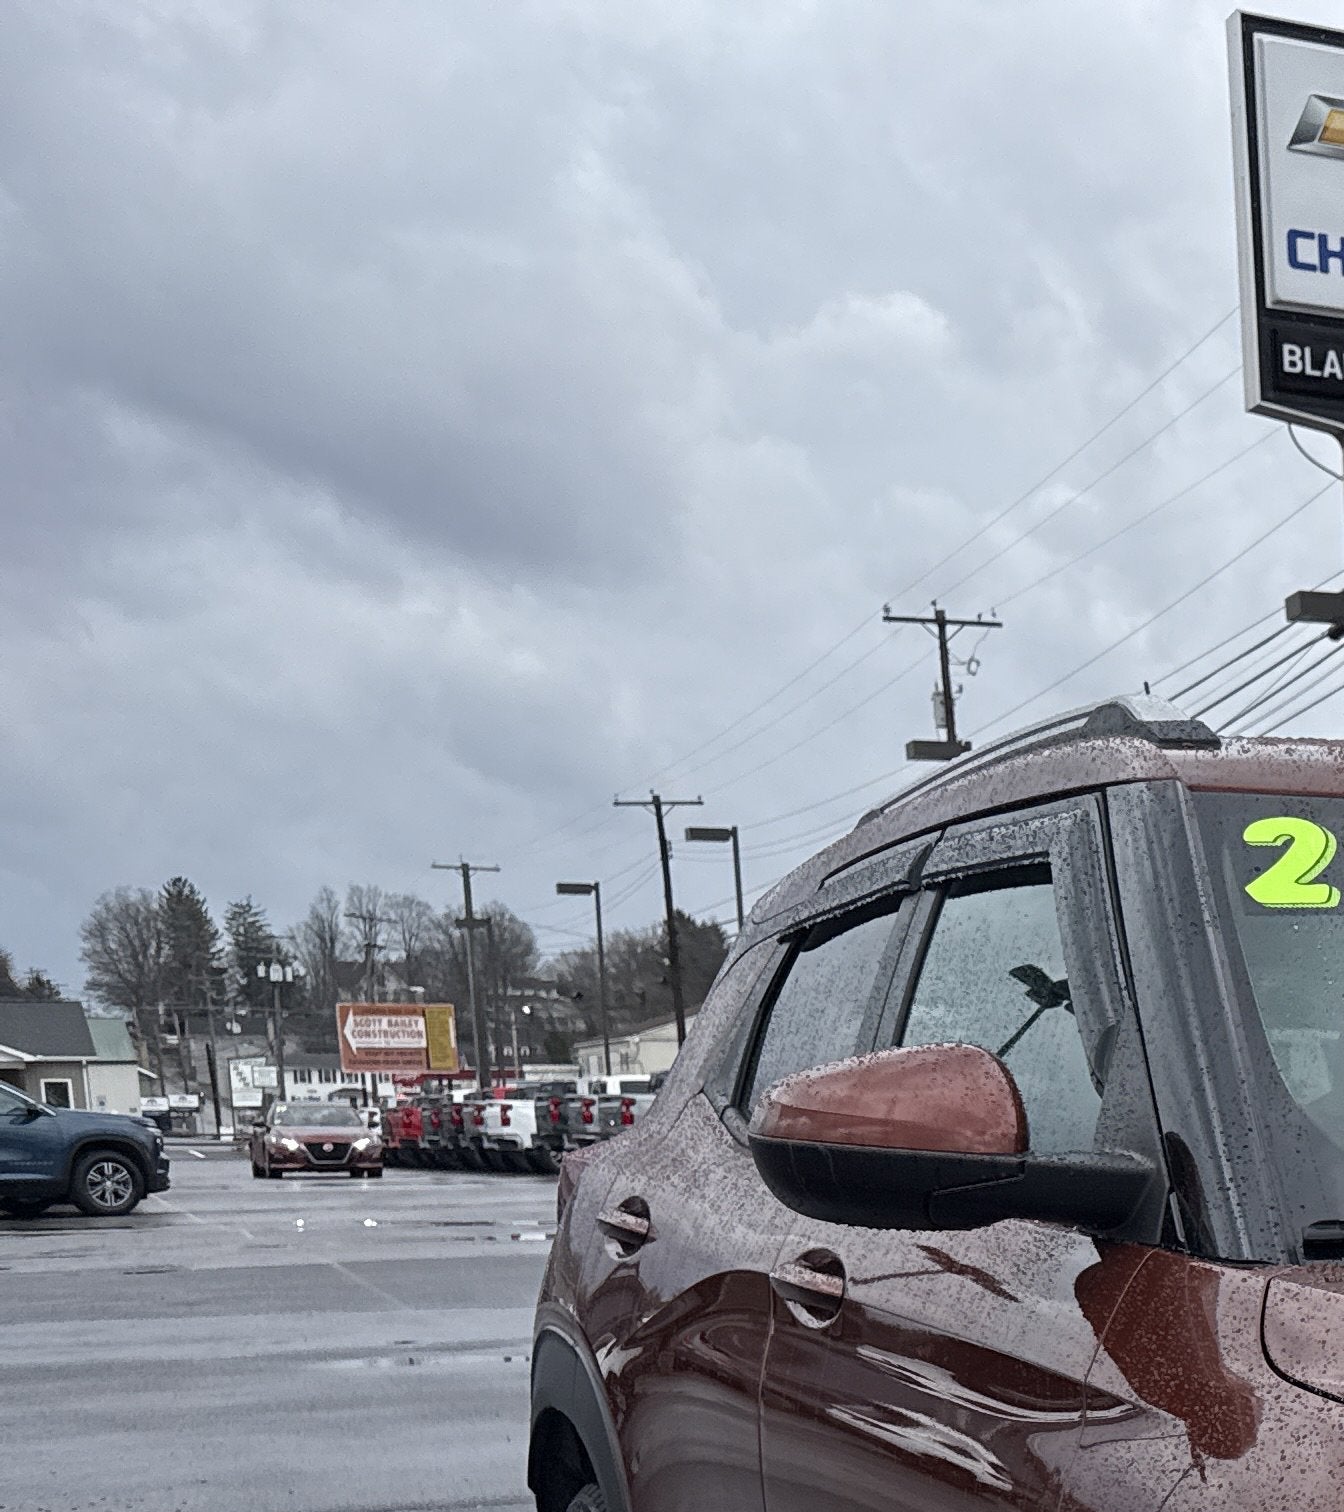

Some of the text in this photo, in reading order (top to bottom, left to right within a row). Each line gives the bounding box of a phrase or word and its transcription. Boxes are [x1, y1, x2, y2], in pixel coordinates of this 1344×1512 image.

[354, 1017, 420, 1028] SCOTT BAILEY
[352, 1029, 424, 1040] CONSTRUCTION
